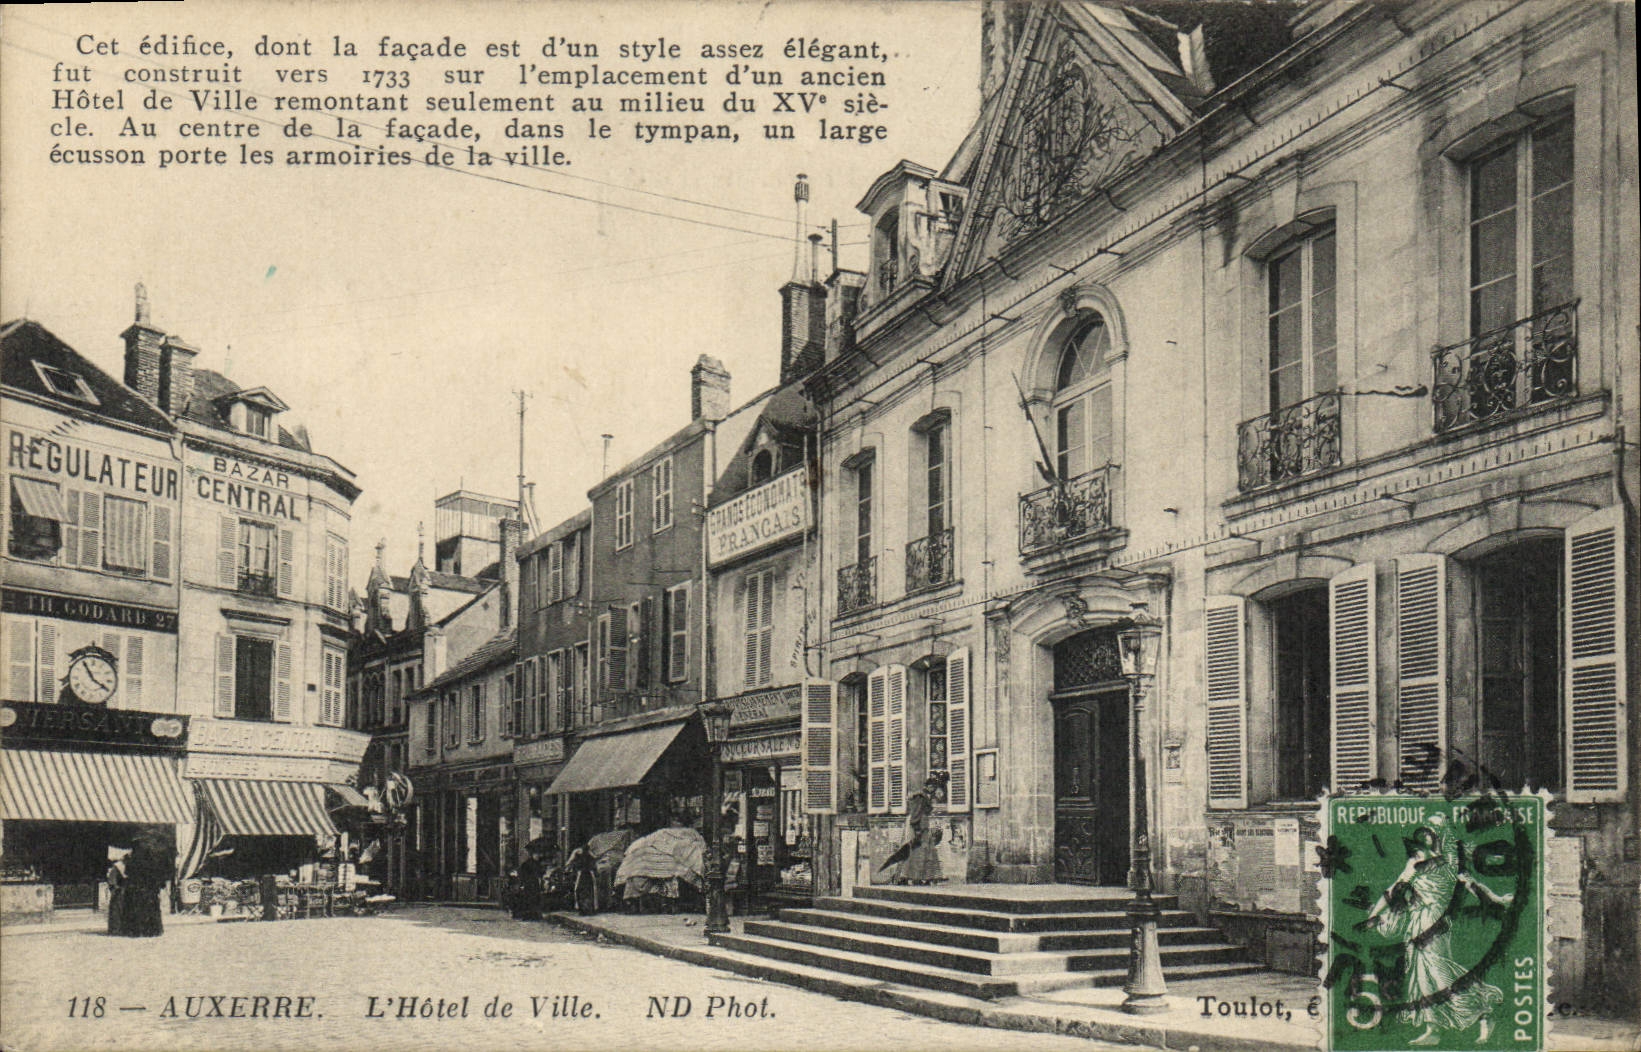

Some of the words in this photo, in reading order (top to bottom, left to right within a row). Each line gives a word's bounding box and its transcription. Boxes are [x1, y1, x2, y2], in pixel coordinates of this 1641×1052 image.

[213, 457, 290, 489] BAZAR
[198, 475, 301, 521] CENTRAL
[64, 600, 147, 626] GODARD
[155, 612, 177, 630] 27
[1514, 956, 1534, 1041] POSTES
